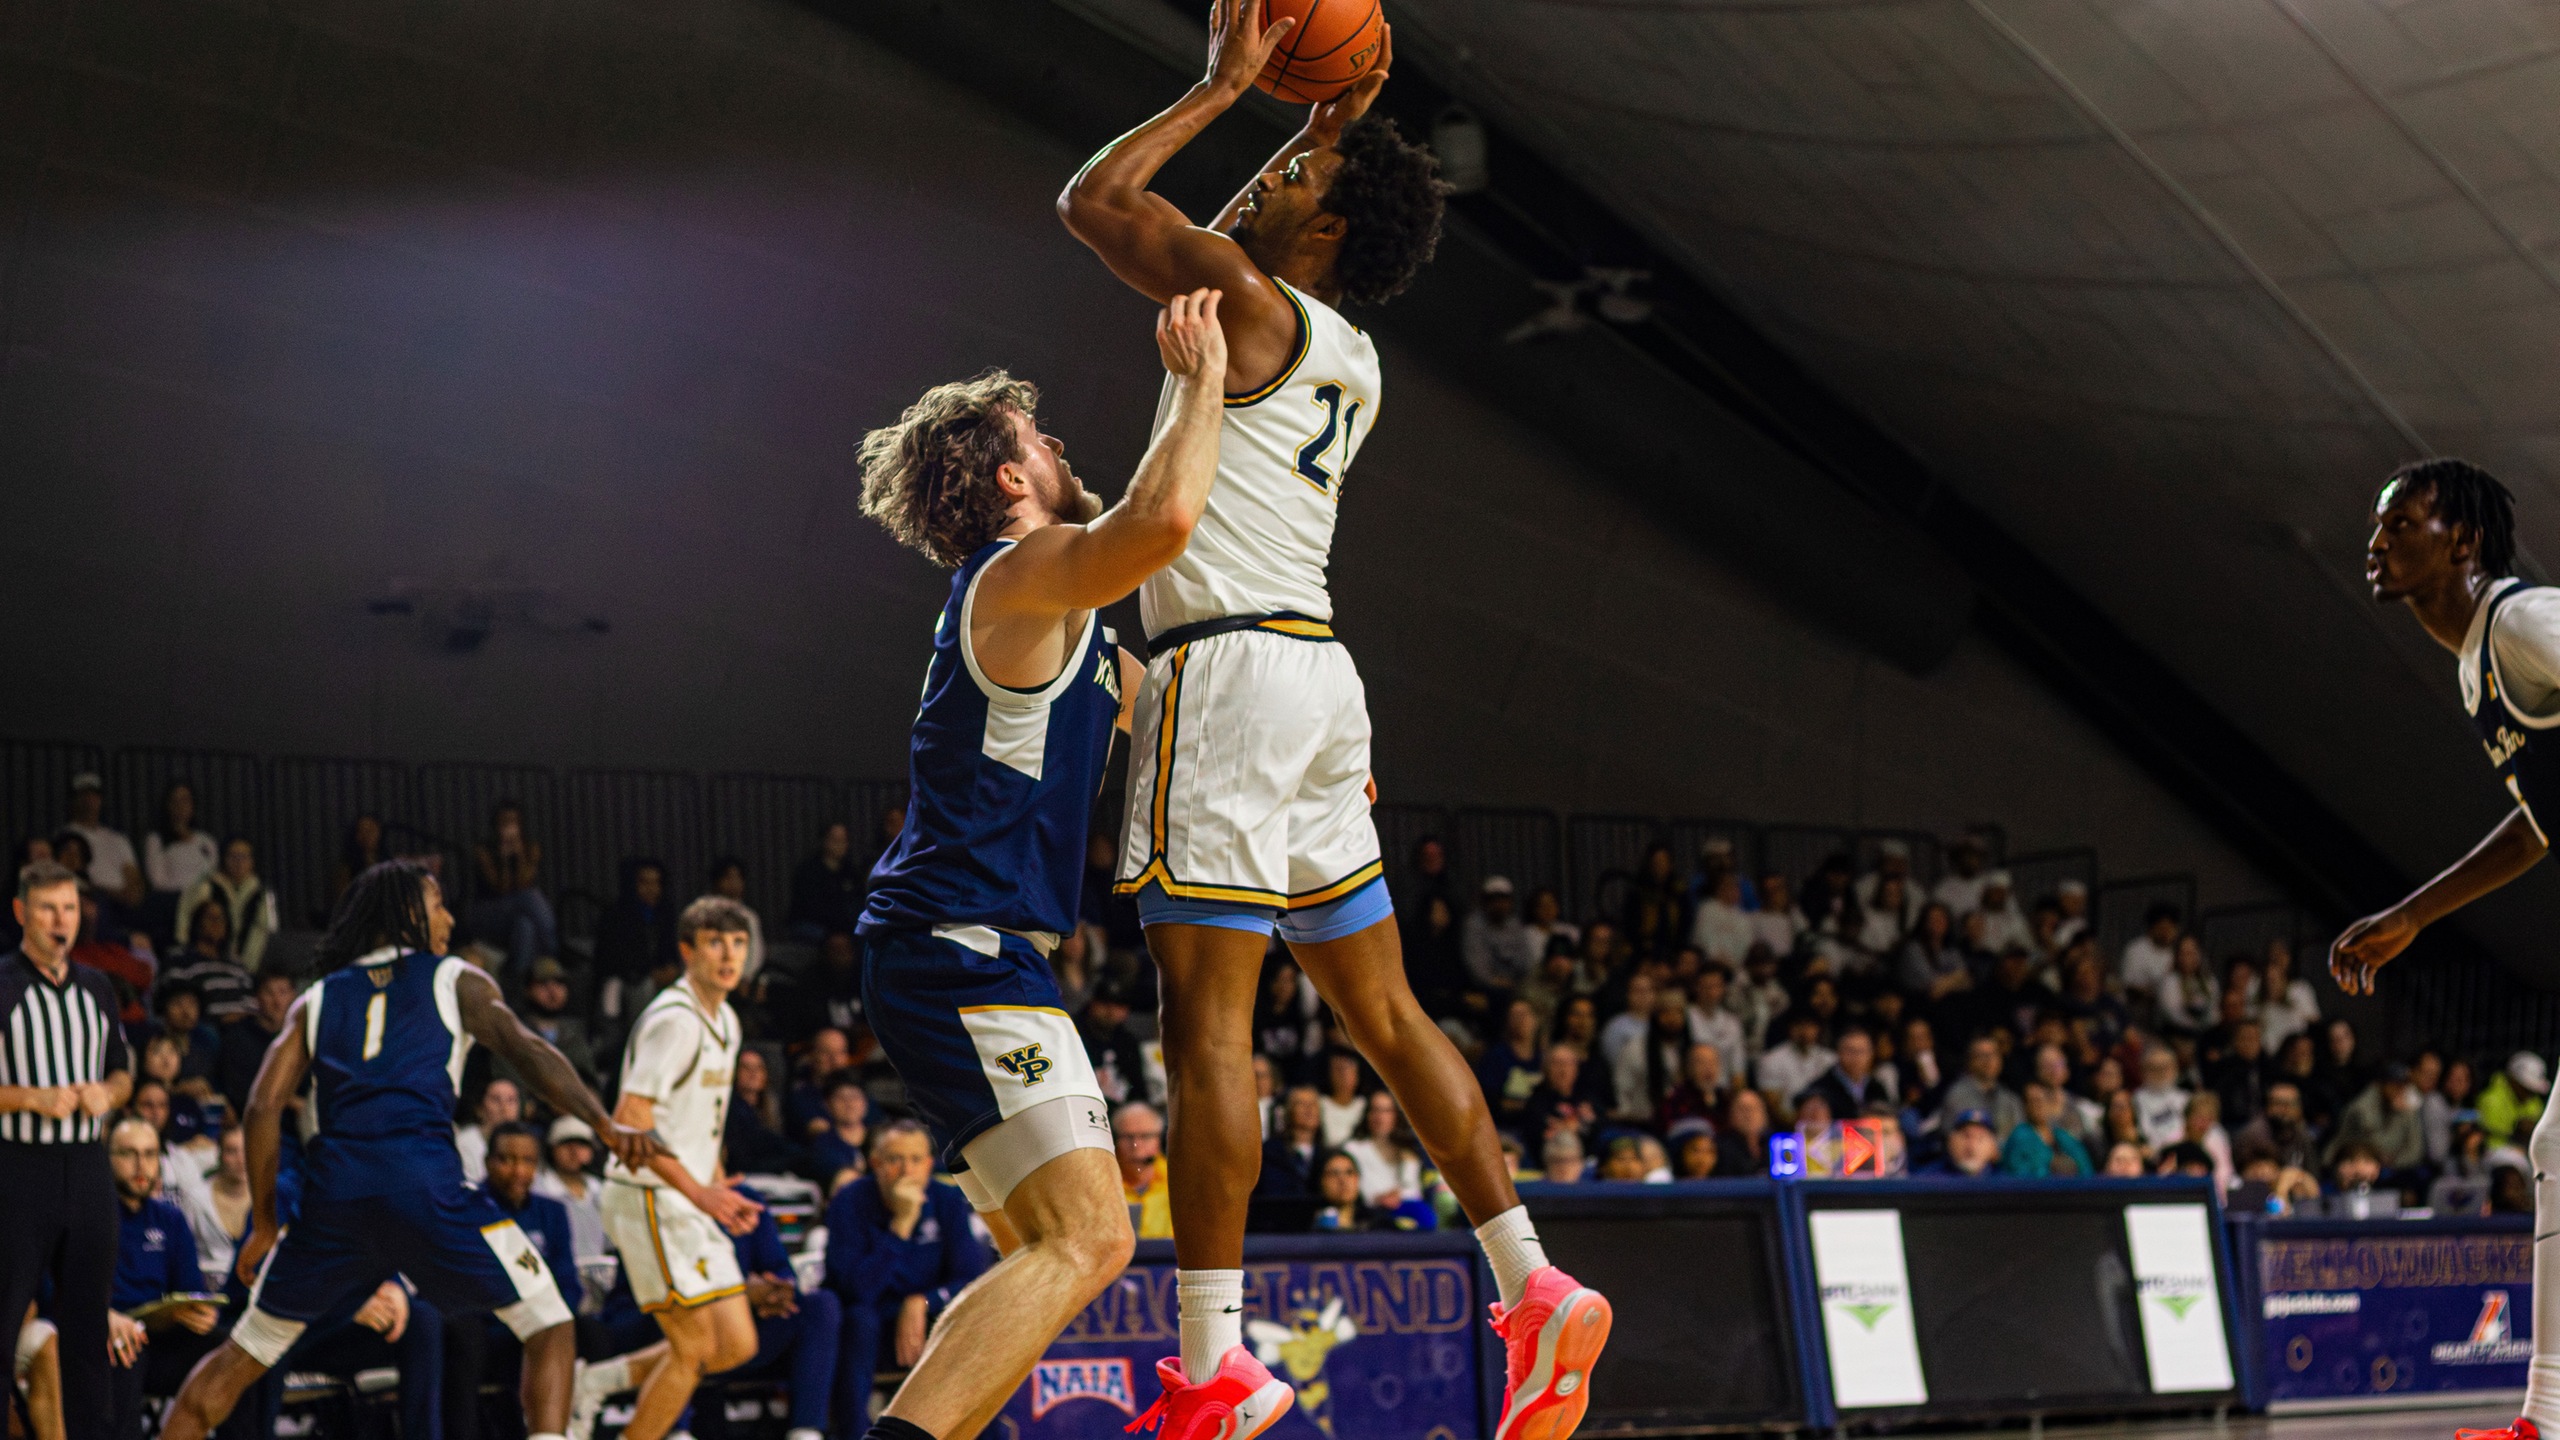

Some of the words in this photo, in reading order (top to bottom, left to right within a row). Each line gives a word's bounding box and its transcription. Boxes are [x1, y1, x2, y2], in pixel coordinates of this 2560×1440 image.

[1291, 379, 1366, 503] 21
[362, 992, 388, 1063] 1
[995, 1043, 1053, 1087] WP
[2262, 1237, 2534, 1290] YELLOWJACKE
[1038, 1364, 1127, 1406] NAIA
